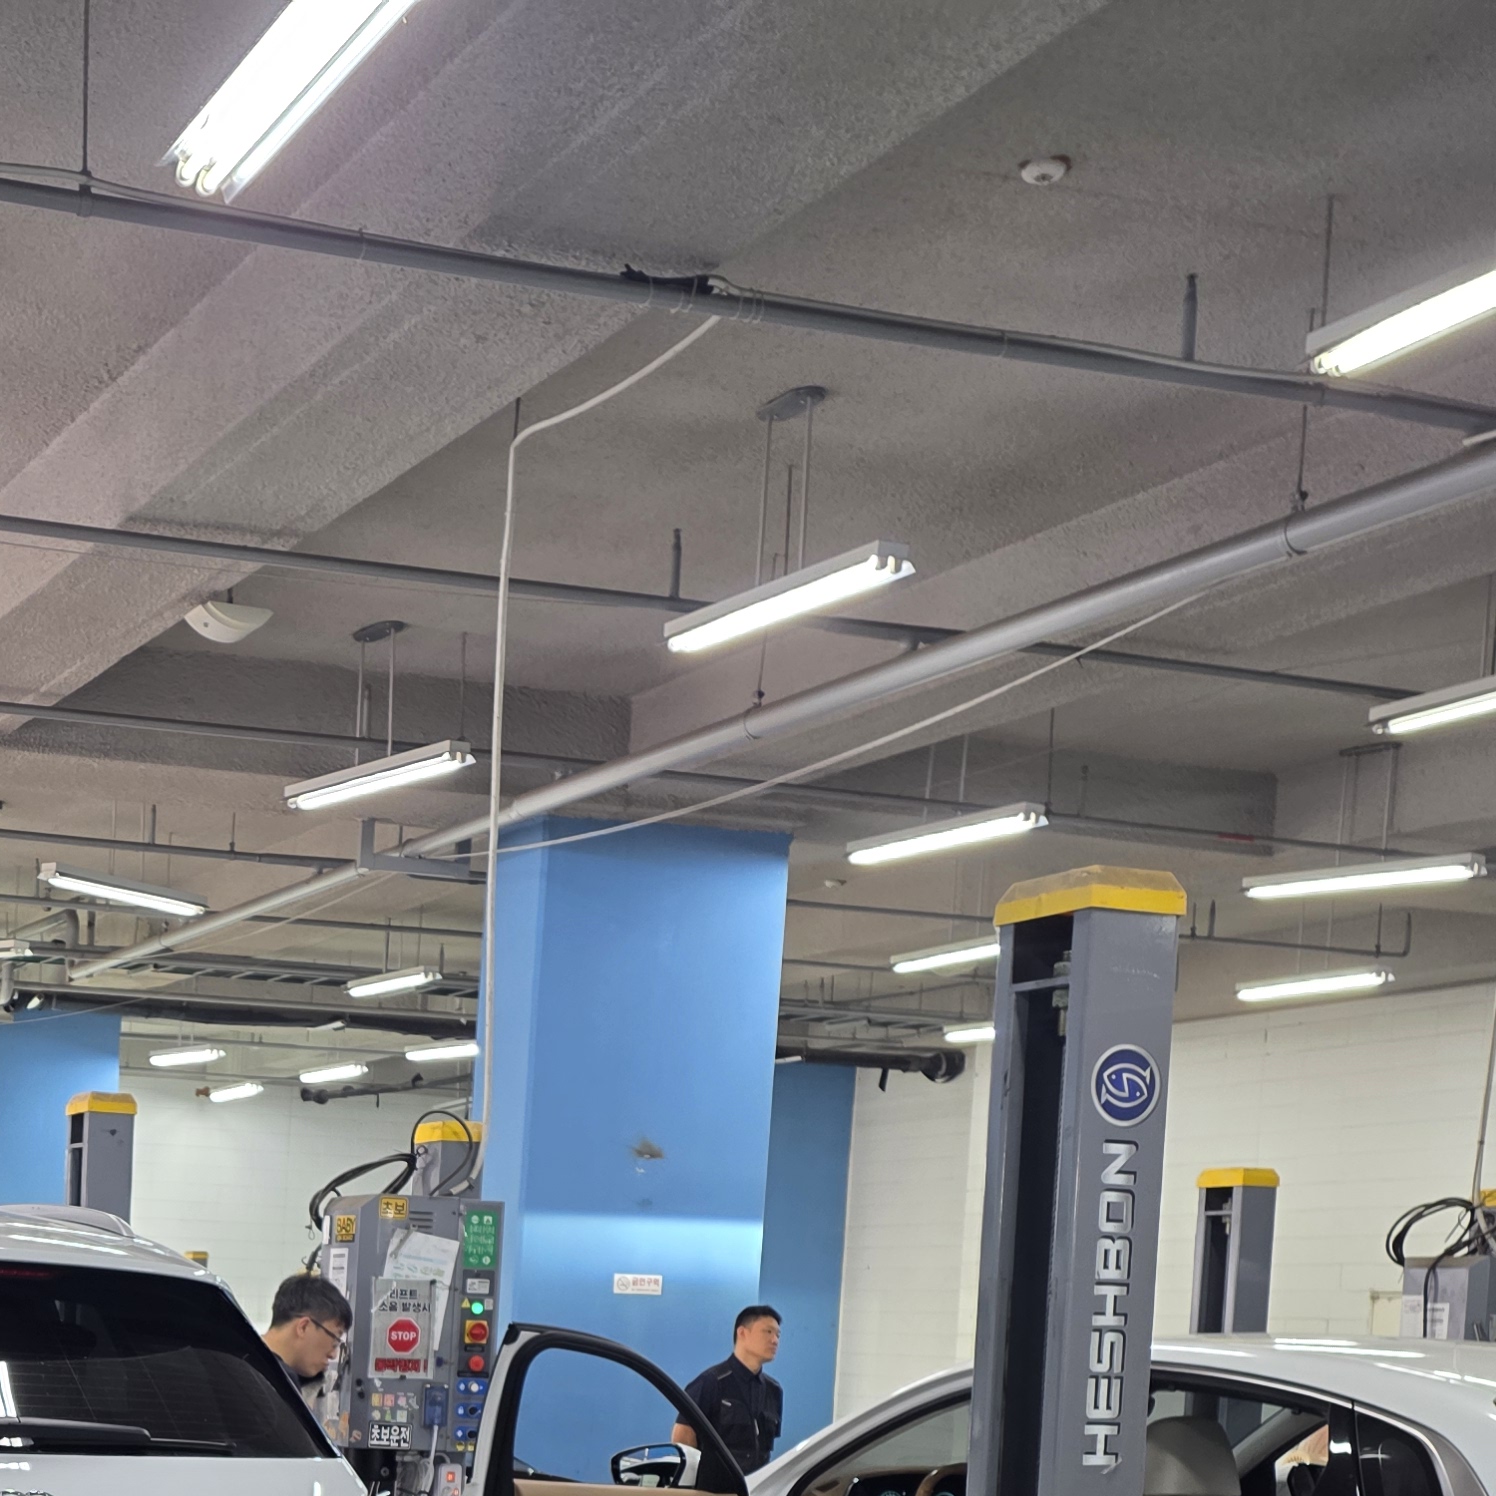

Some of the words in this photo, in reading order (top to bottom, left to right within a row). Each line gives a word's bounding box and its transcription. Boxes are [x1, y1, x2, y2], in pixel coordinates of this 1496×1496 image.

[381, 1200, 406, 1215] 초보
[336, 1217, 354, 1233] BABY
[1082, 1140, 1139, 1466] HESHBON
[391, 1331, 416, 1341] STOP
[371, 1425, 410, 1447] 초보운전
